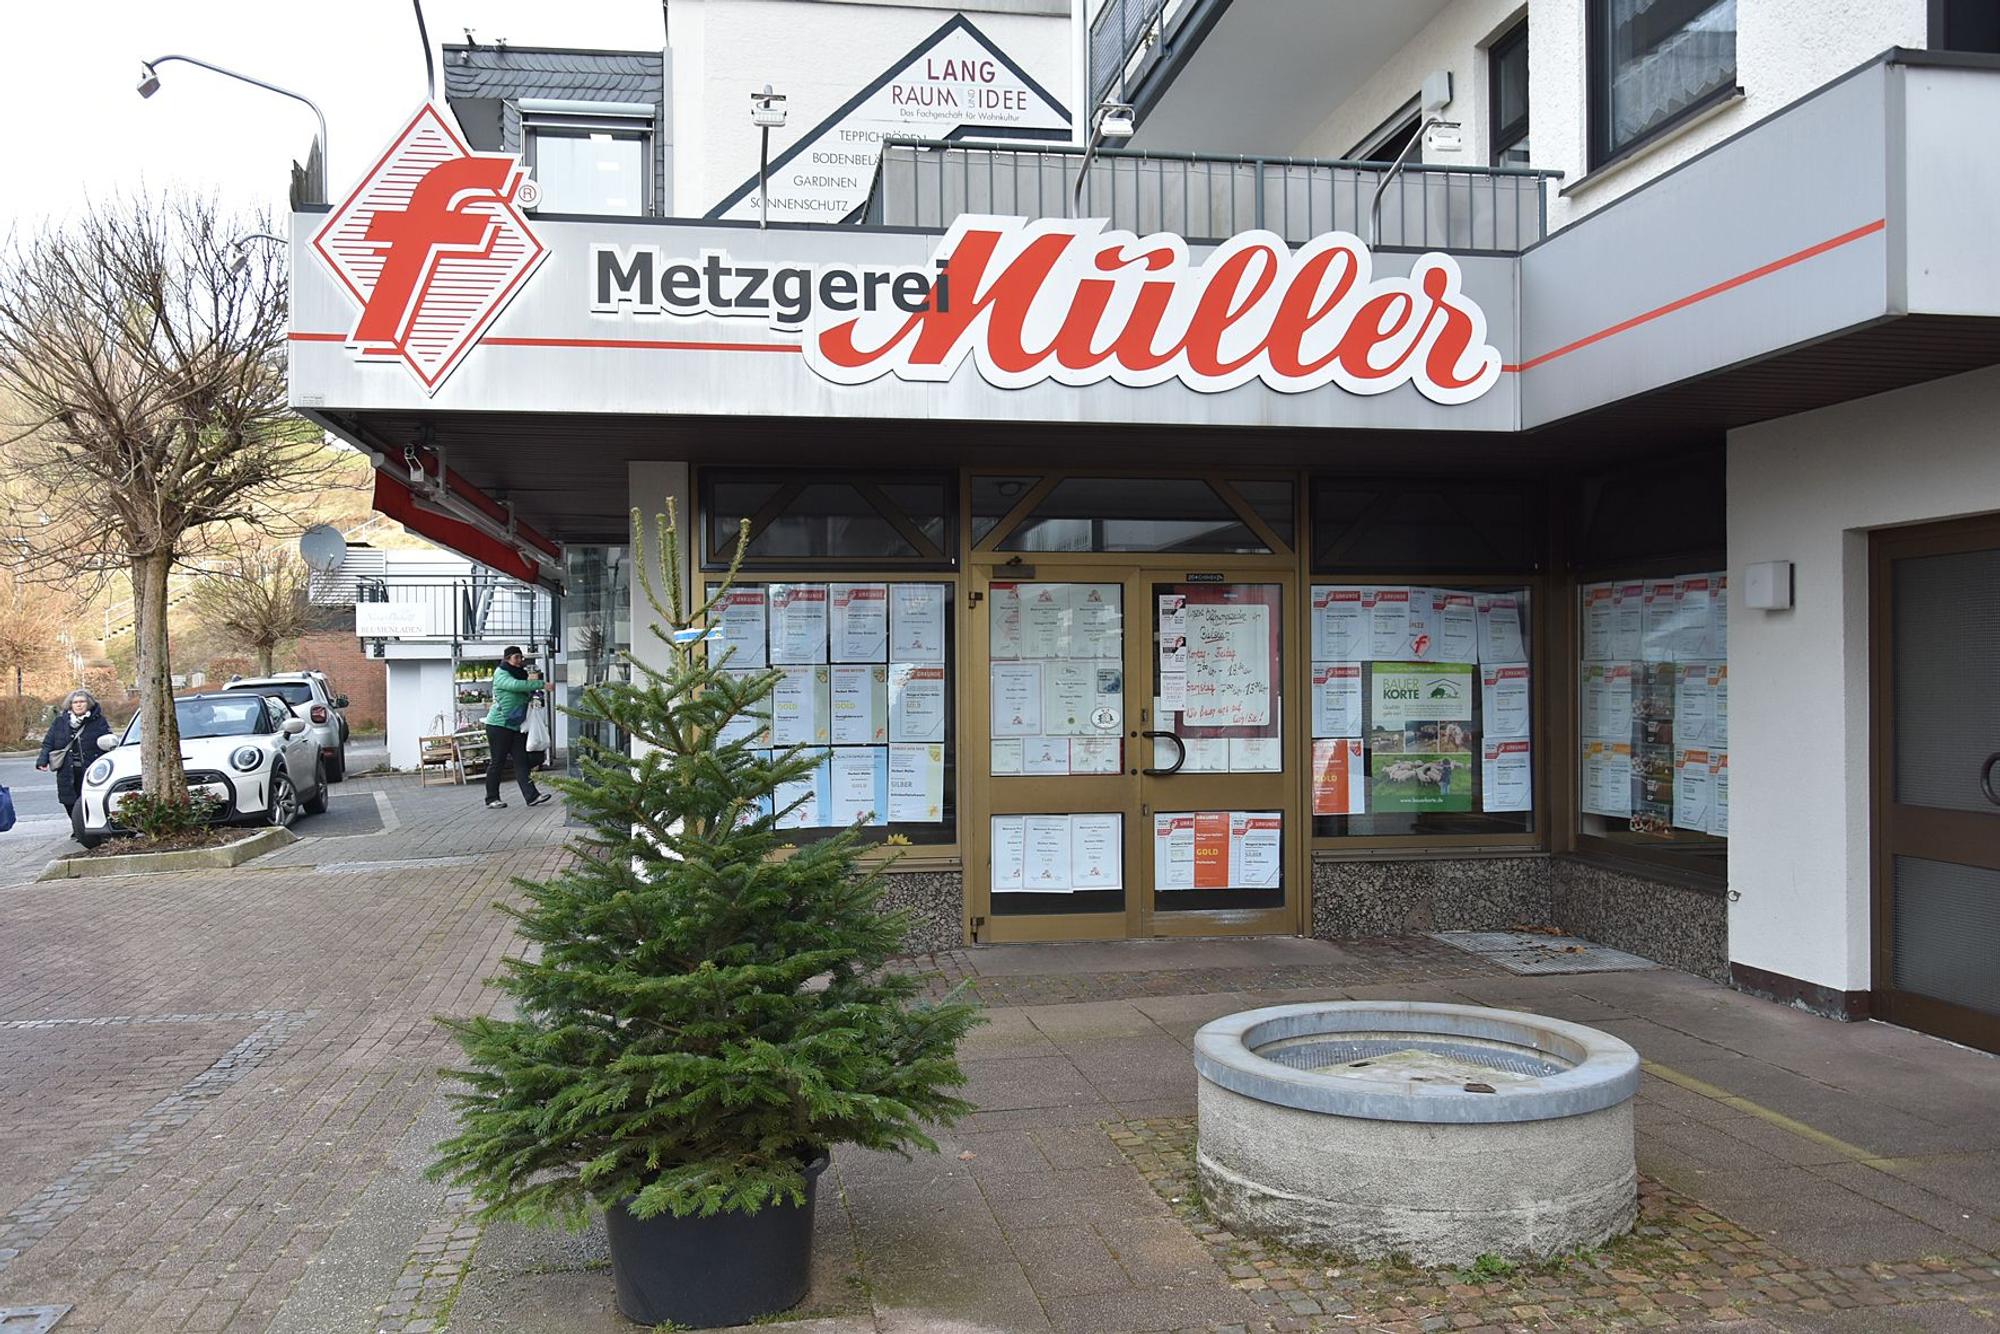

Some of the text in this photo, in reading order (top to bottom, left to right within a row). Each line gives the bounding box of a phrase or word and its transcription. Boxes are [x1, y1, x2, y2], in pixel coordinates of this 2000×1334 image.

[927, 58, 996, 84] LANG
[892, 85, 958, 108] RAUM
[978, 89, 1027, 111] IDEE
[900, 108, 1020, 122] Das Fachgeschäft für Wohnkultur
[793, 175, 857, 188] GARDINEN
[597, 229, 1488, 389] Metzgerei Müller
[1383, 678, 1420, 690] BAUER
[1383, 690, 1420, 699] KORTE
[1196, 848, 1219, 856] GOLD
